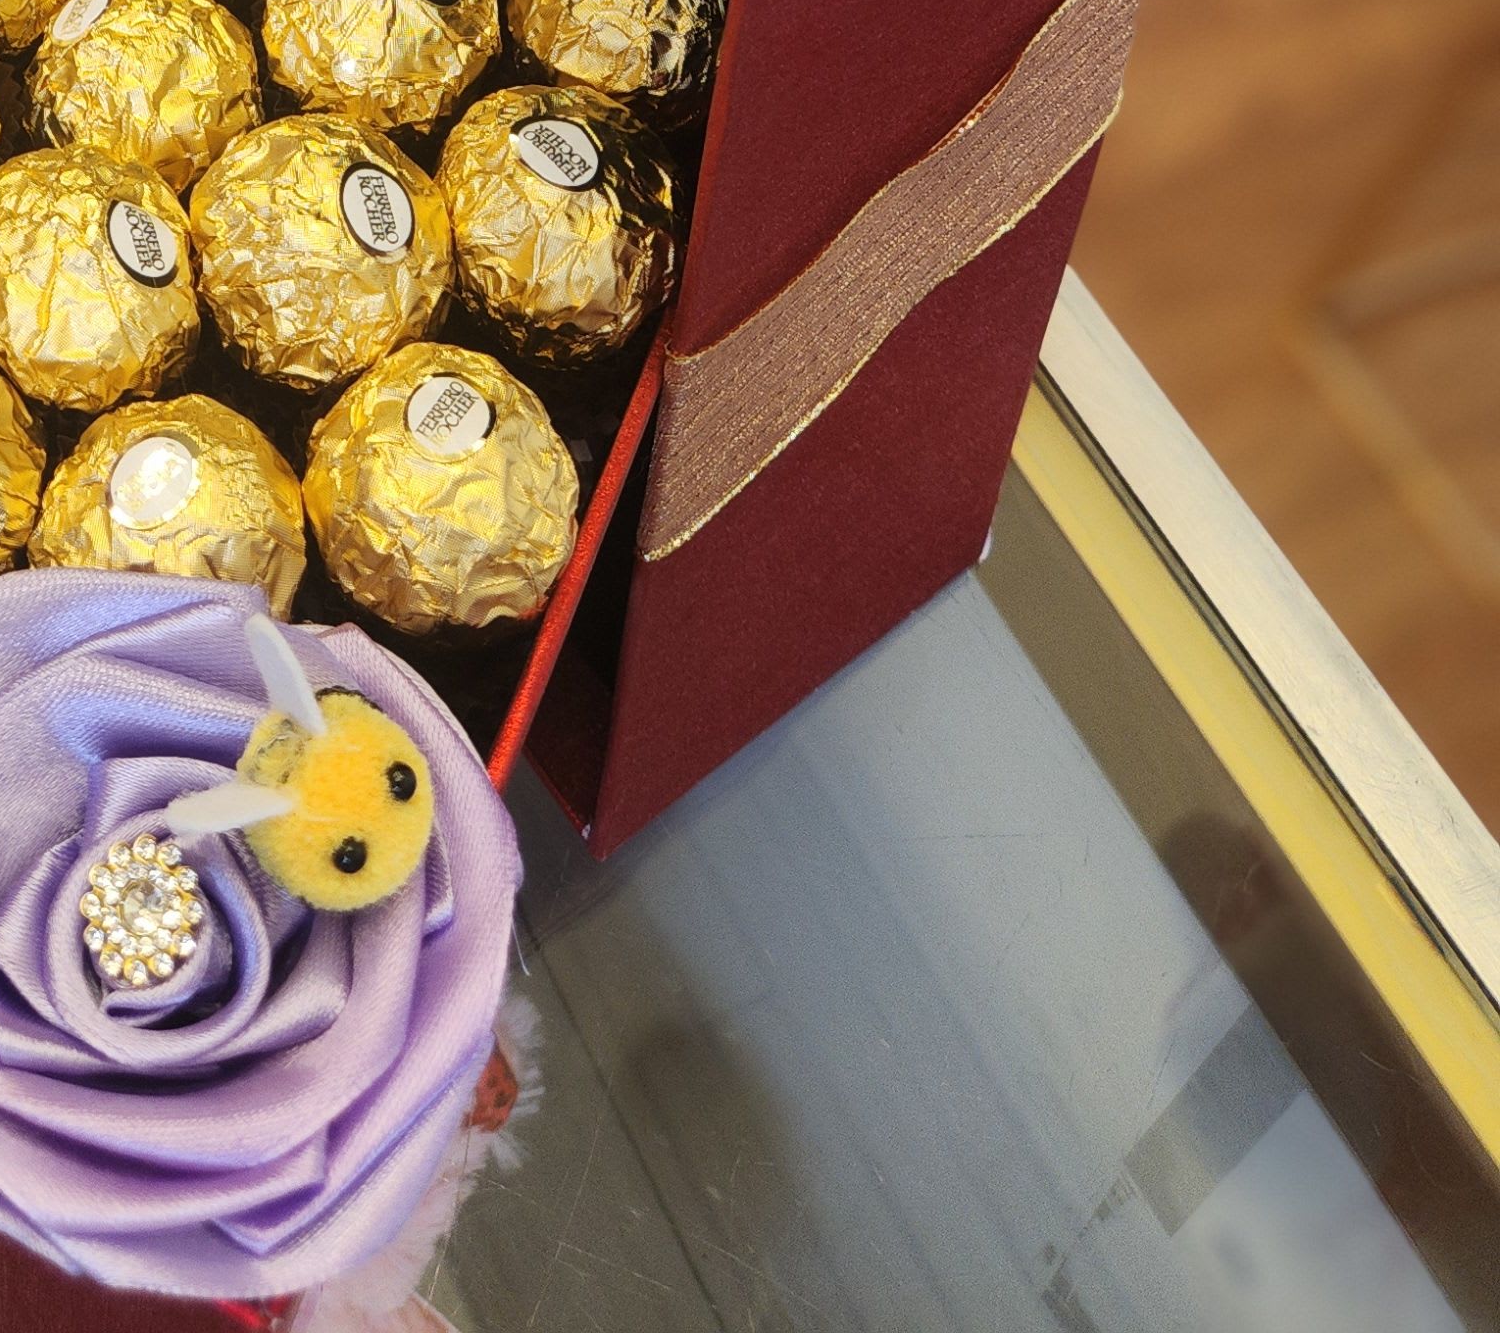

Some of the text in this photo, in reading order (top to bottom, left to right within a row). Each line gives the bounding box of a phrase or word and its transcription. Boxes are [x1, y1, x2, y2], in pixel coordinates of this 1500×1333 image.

[522, 129, 582, 183] FERRERO
[533, 124, 593, 176] ROCHER
[123, 204, 152, 271] ROCHER
[357, 174, 386, 245] ROCHER
[369, 174, 400, 245] FERRERO
[415, 380, 465, 437] FERRERO
